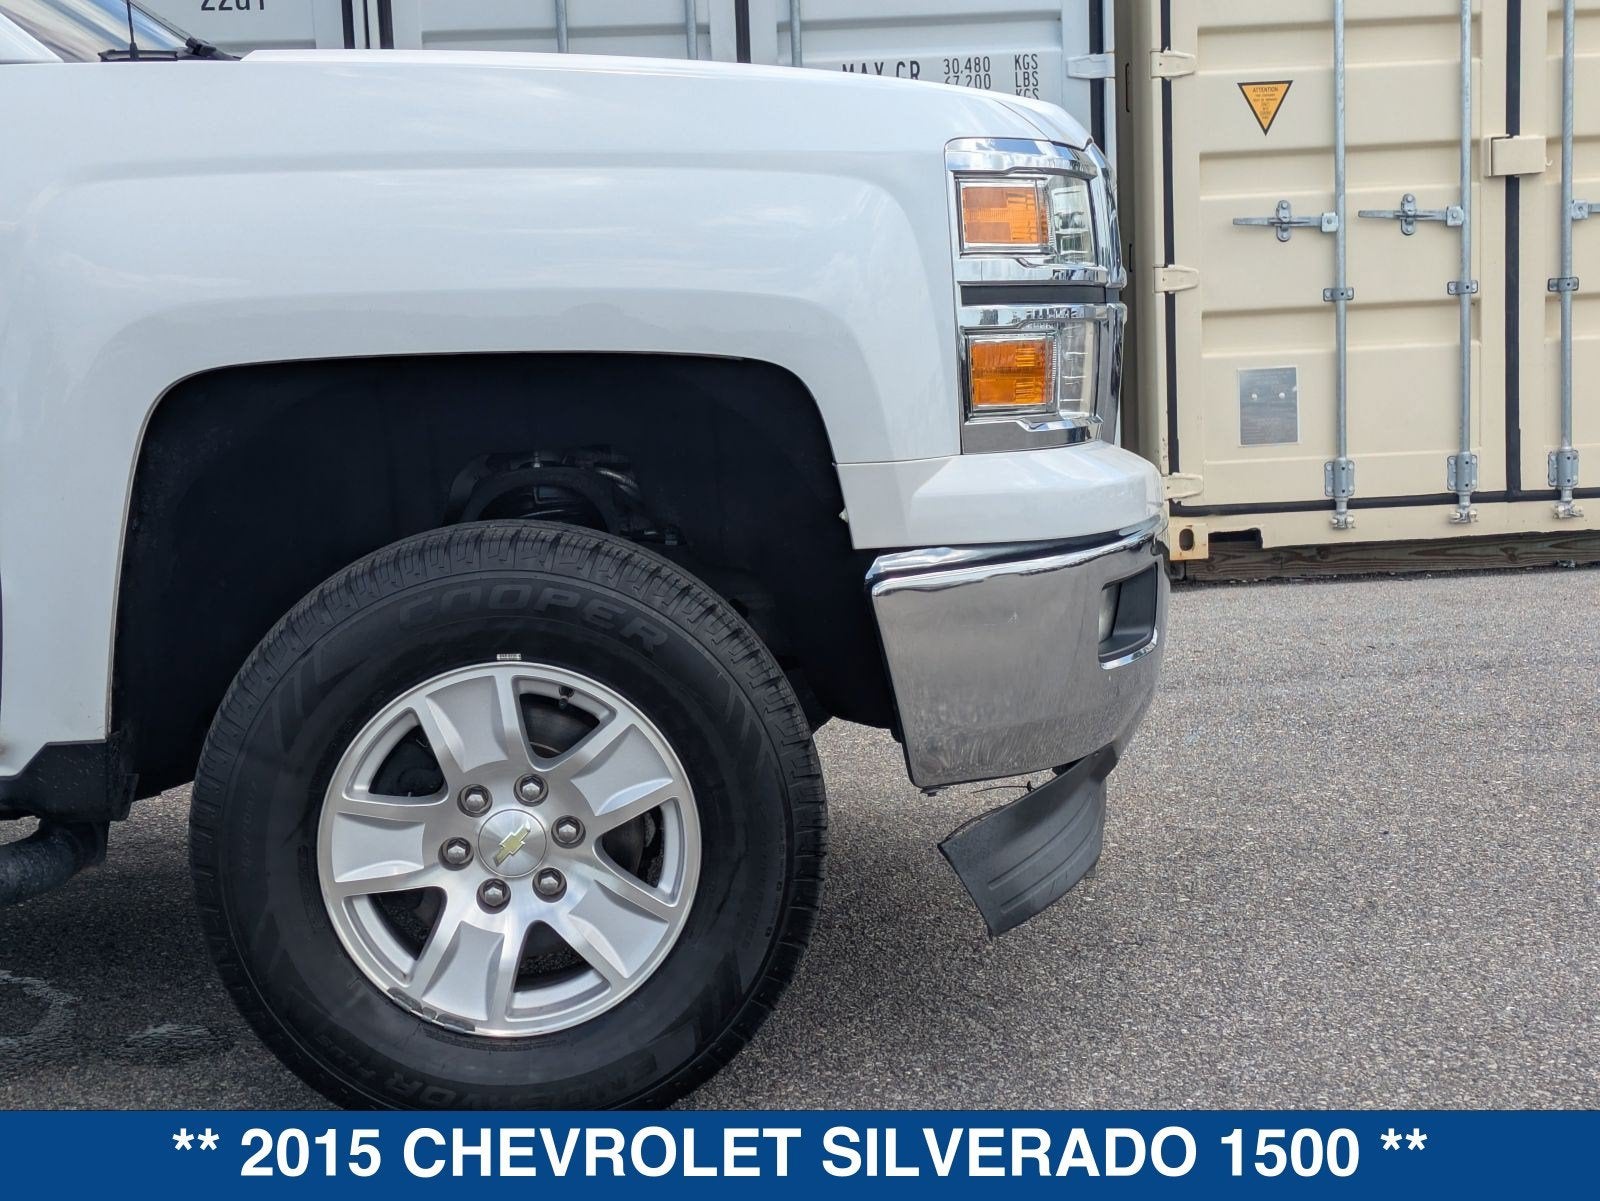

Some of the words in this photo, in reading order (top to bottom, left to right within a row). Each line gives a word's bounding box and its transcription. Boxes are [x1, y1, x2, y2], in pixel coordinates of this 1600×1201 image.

[1014, 54, 1038, 71] KGS
[1015, 71, 1039, 88] LBS
[399, 583, 669, 652] COOPER
